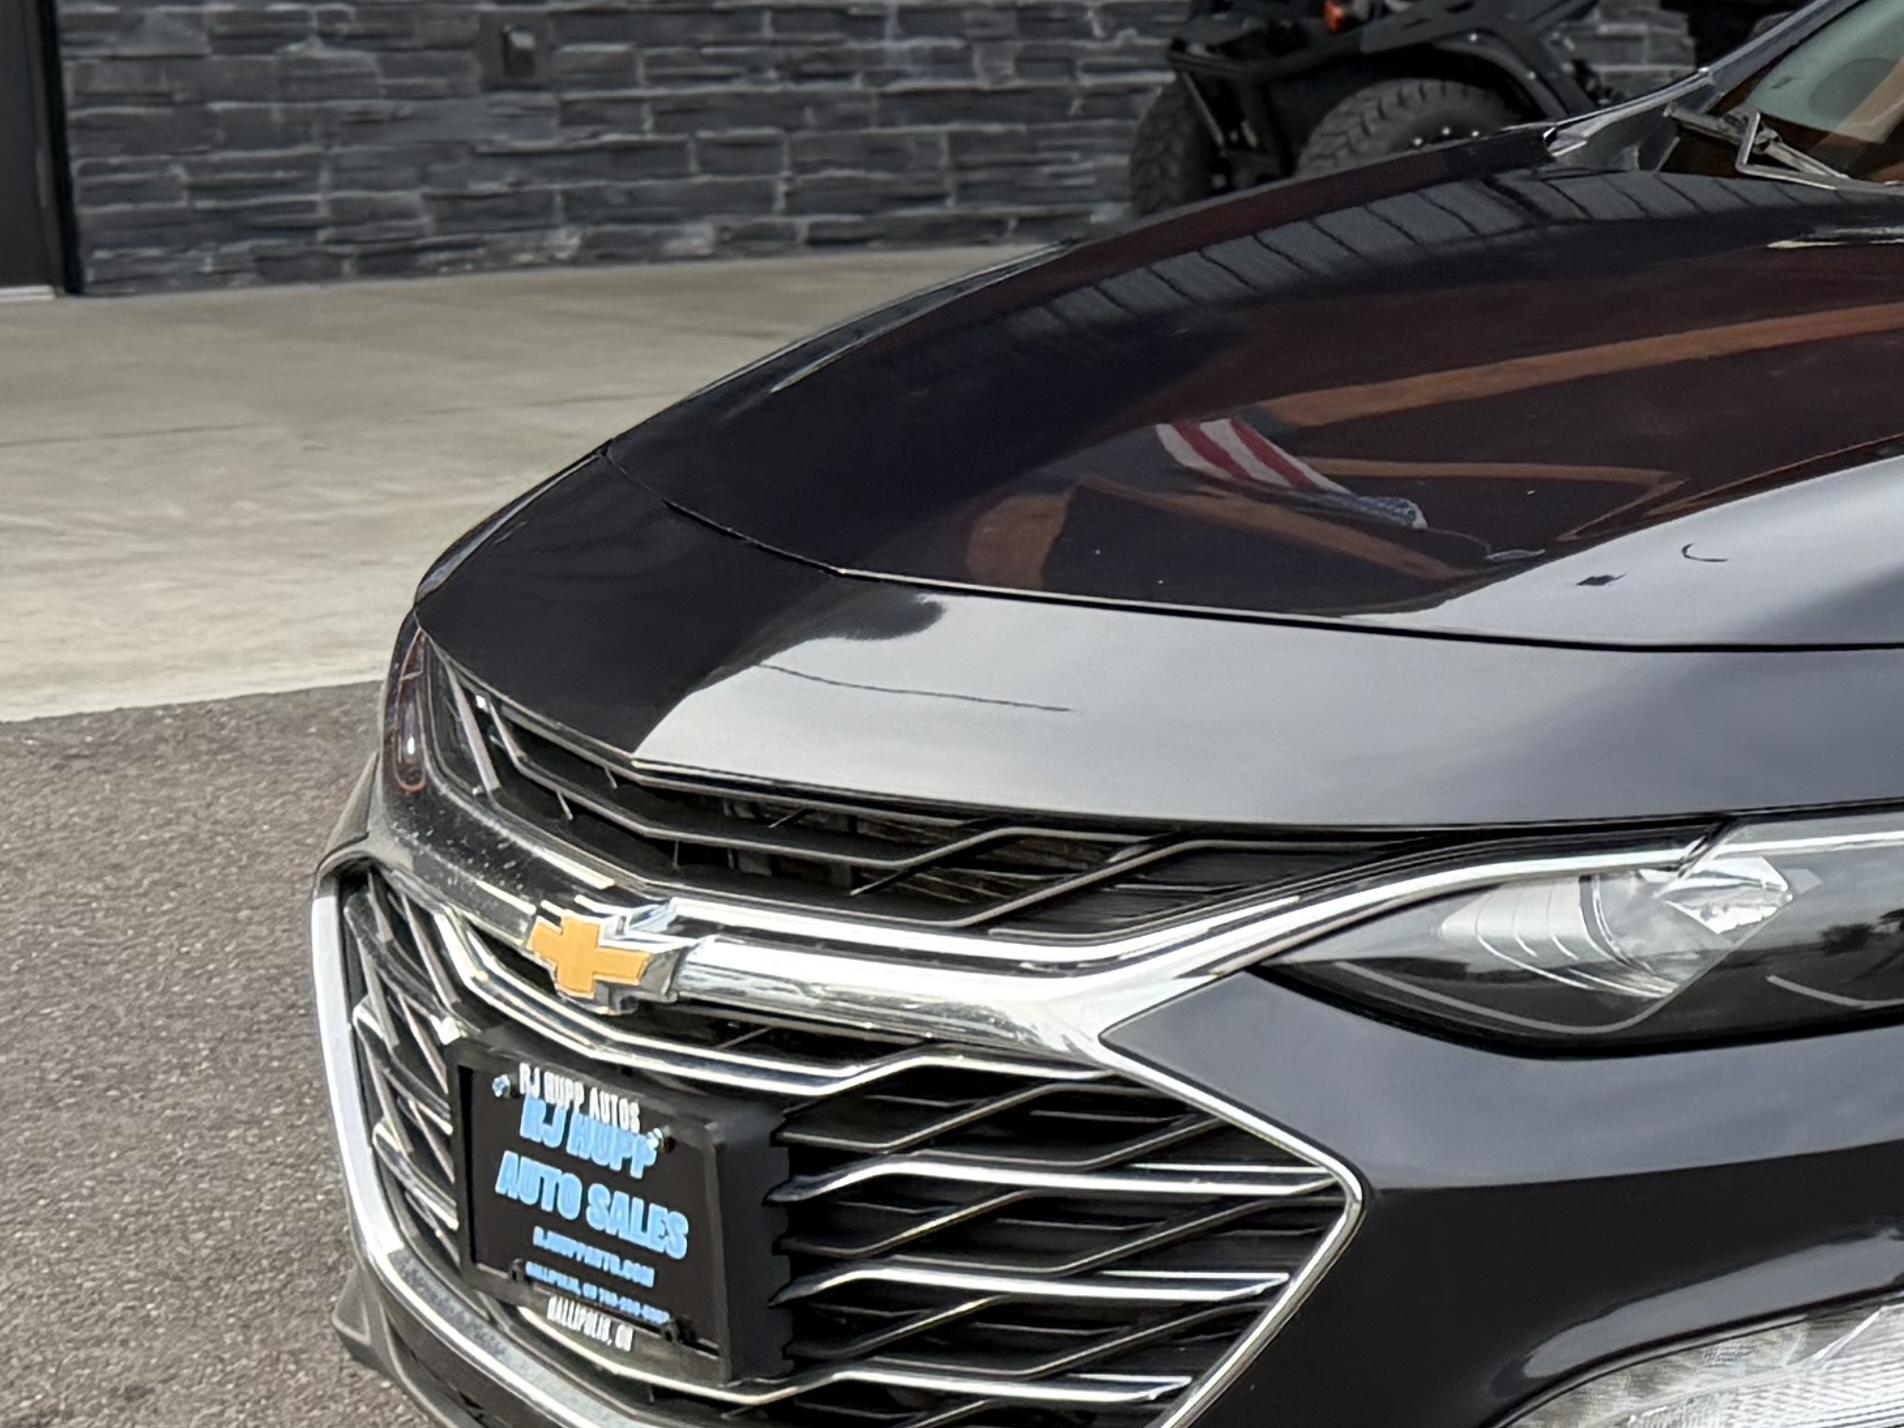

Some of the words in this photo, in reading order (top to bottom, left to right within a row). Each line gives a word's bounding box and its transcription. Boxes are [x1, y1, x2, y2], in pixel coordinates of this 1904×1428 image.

[519, 1062, 541, 1099] RJ
[589, 1087, 641, 1134] AUTOS
[495, 1150, 583, 1220] AUTO
[586, 1183, 690, 1260] SALES
